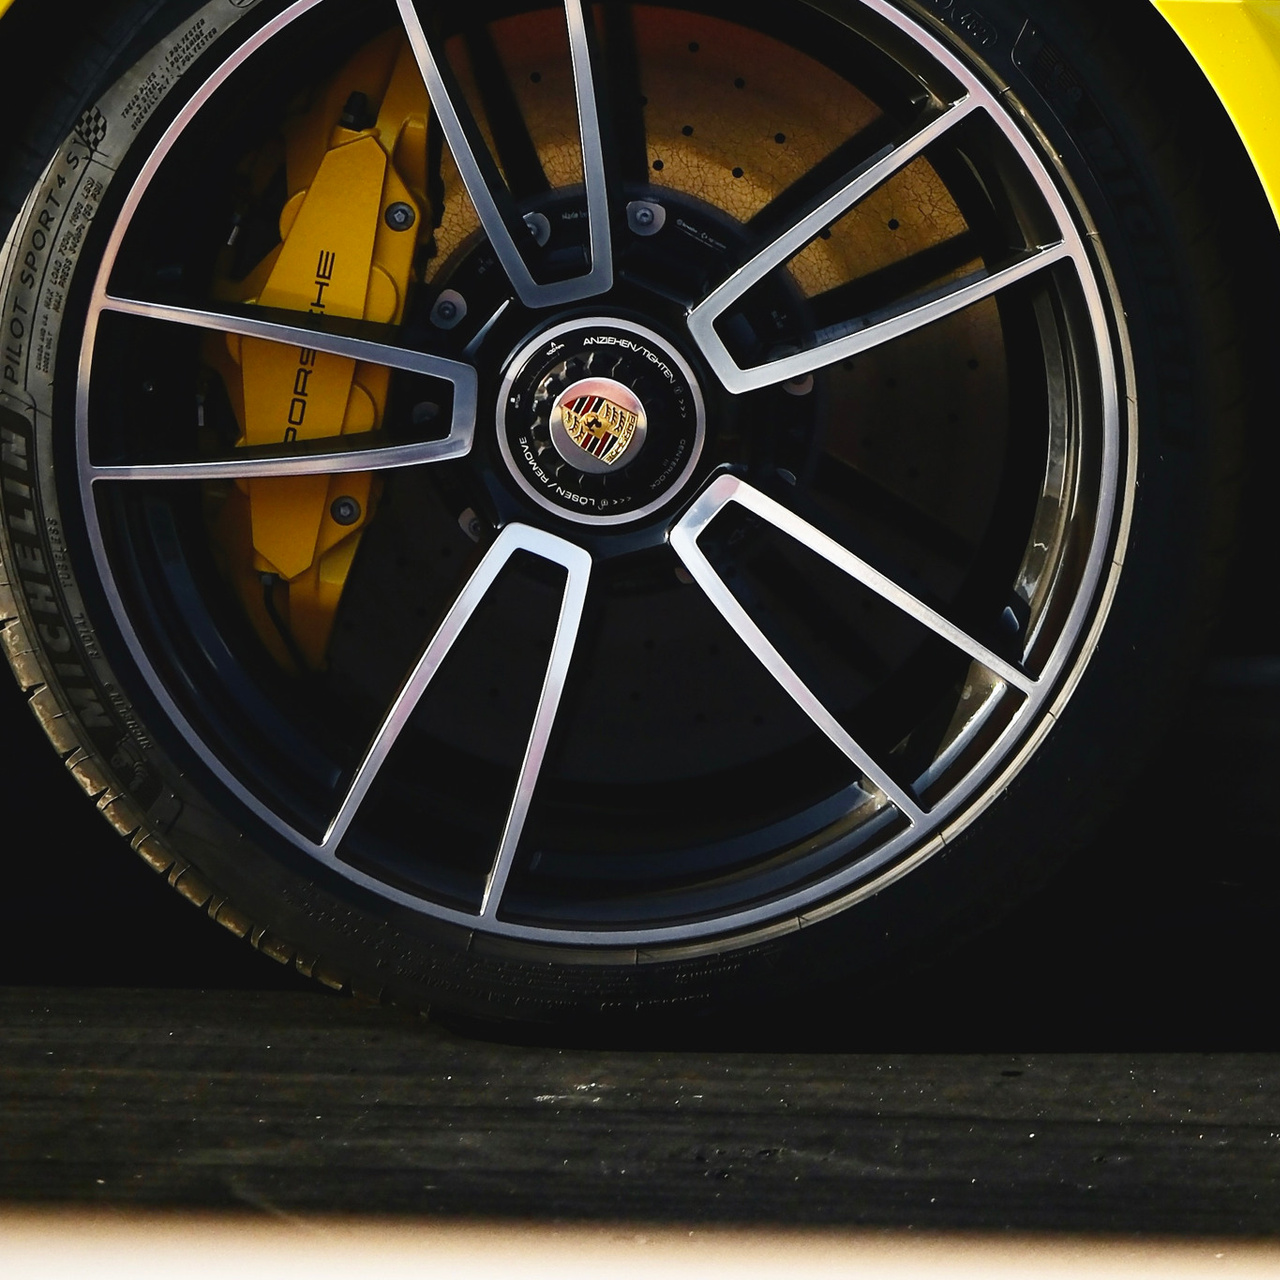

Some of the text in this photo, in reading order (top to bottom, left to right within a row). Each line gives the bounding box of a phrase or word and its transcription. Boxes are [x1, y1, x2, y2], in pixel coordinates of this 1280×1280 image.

[3, 150, 83, 384] PILOT SPORT 4 S
[43, 287, 54, 309] MAX
[49, 259, 62, 285] LOAD
[57, 257, 72, 288] PRESS
[52, 291, 63, 313] MAX
[283, 249, 336, 444] PORSHE
[583, 336, 677, 385] ANZIEHEN/TIGHTEN
[0, 425, 115, 730] MICHELIN
[73, 612, 102, 660] RADIAL
